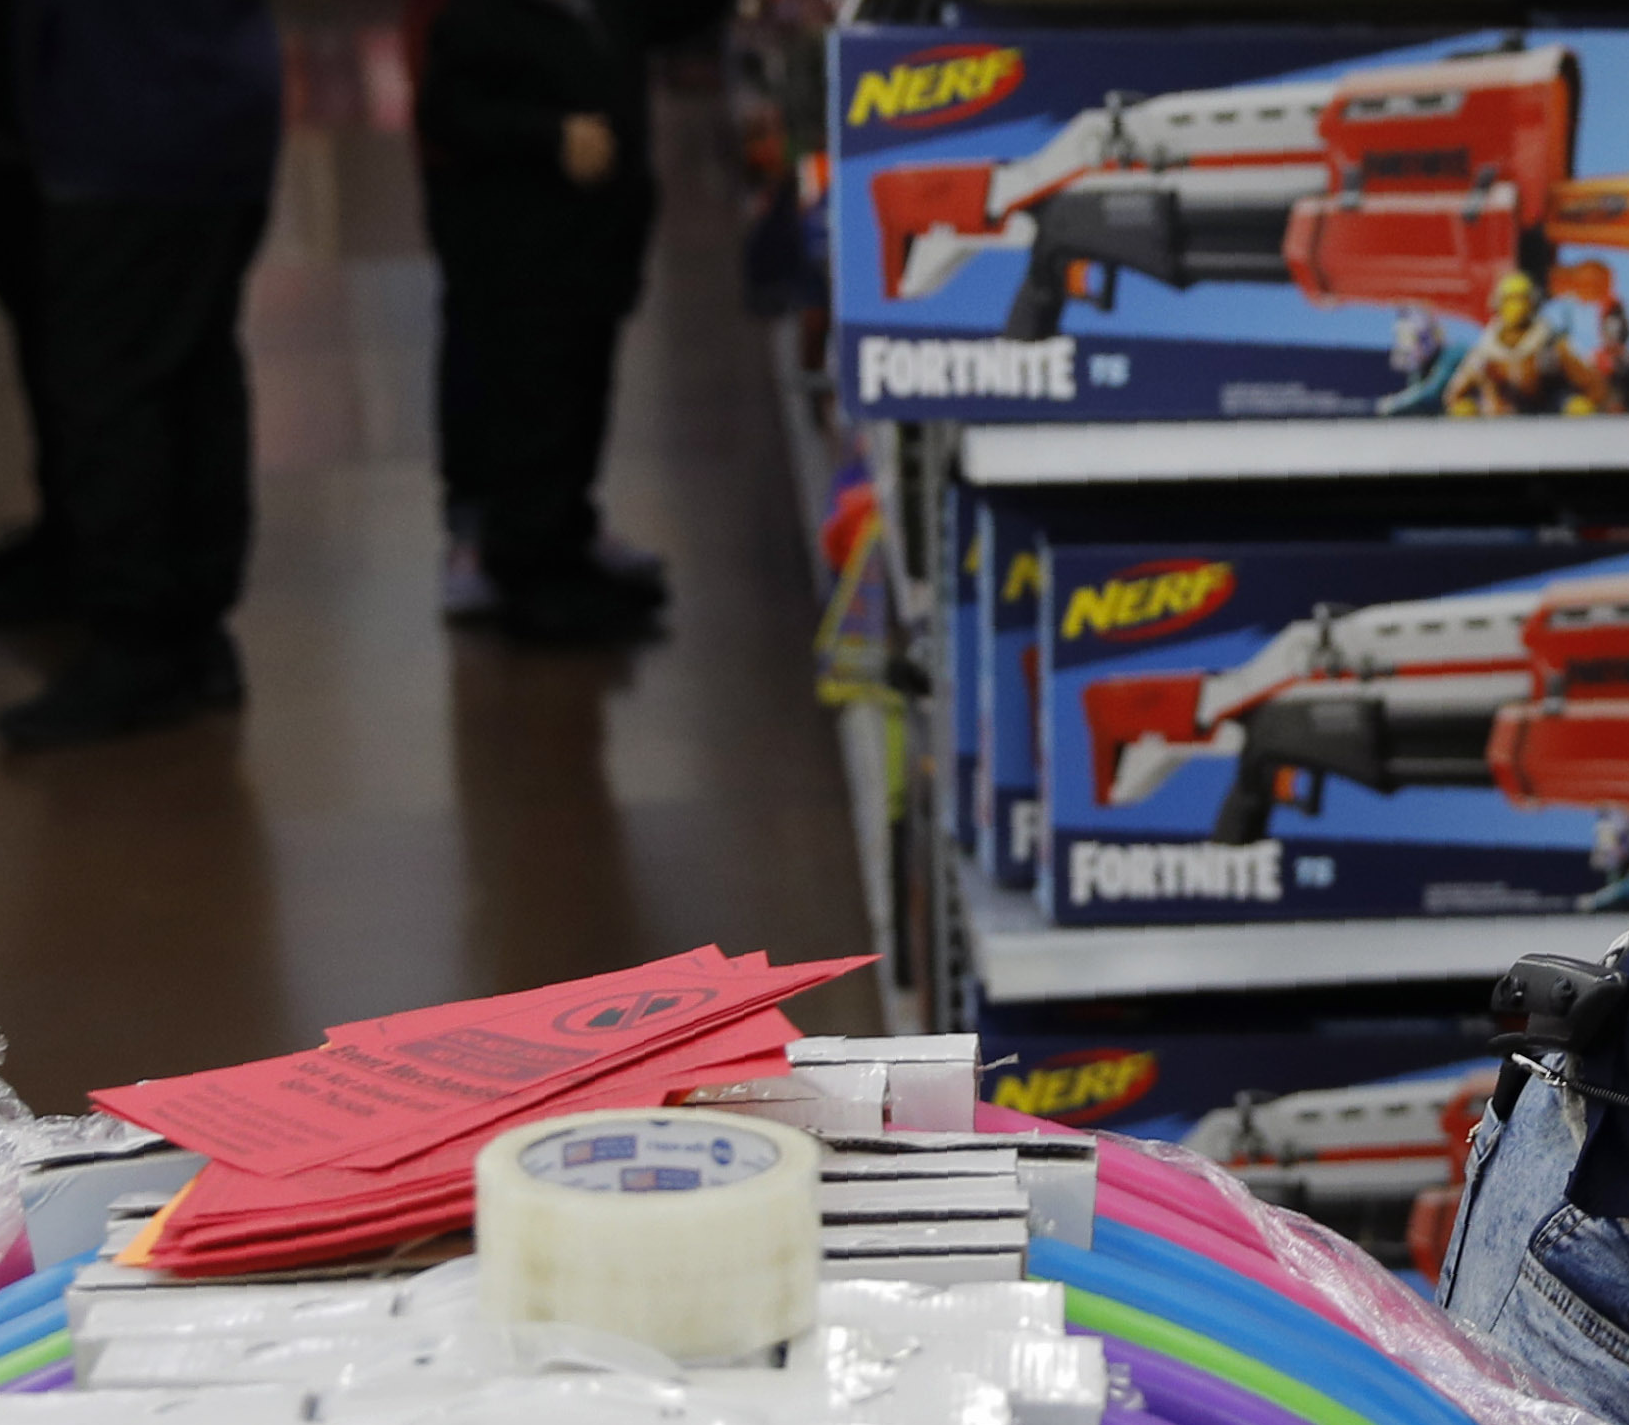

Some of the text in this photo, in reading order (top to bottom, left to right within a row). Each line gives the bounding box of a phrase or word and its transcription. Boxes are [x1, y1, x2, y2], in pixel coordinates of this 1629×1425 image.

[846, 46, 1026, 128] NERF
[857, 335, 1077, 403] FORTNITE
[1061, 561, 1235, 643] NERF
[1069, 840, 1282, 906] FORTNITE
[991, 1050, 1161, 1113] NERF
